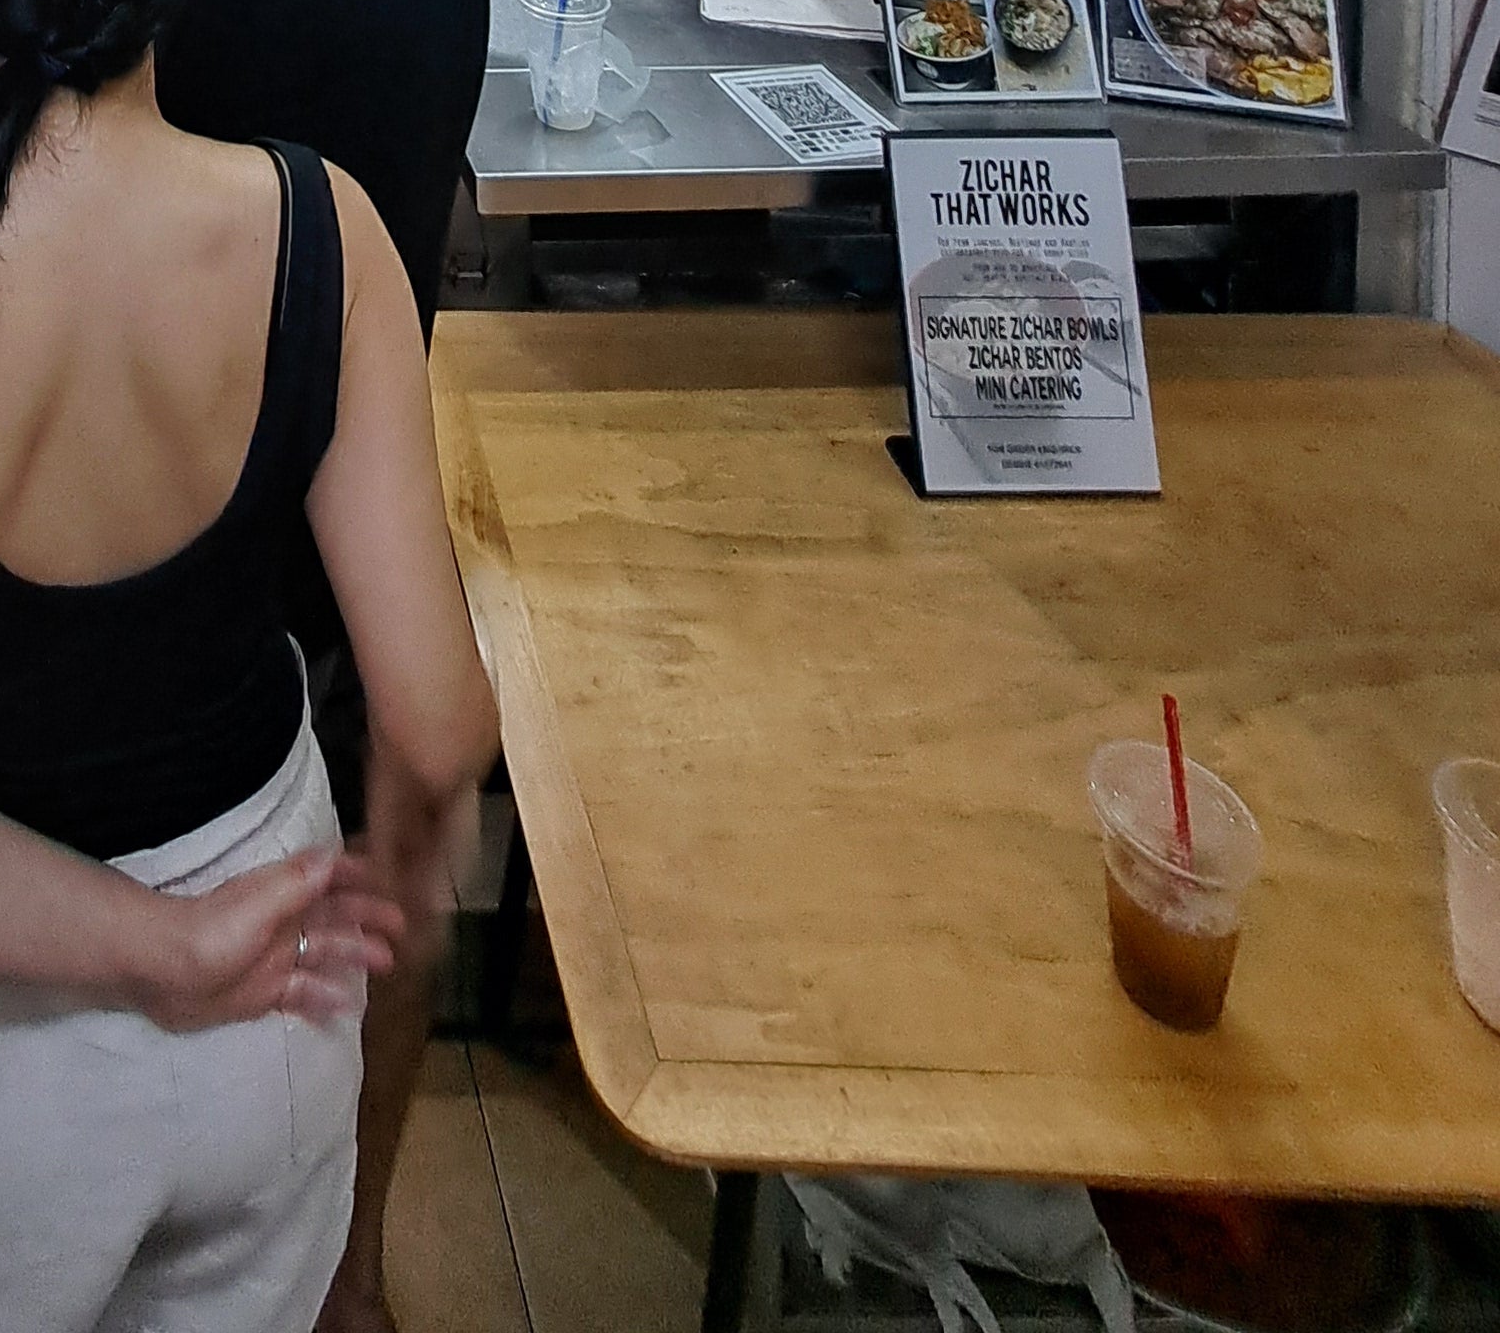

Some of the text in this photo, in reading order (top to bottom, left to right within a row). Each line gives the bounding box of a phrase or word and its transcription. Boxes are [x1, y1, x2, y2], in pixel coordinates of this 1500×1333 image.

[959, 159, 1053, 193] ZICHAR
[930, 193, 1091, 226] THAT WORKS
[927, 316, 1119, 342] SIGNATURE ZICHAR BOWLS
[968, 346, 1083, 370] ZICHAR BENTOS
[975, 376, 1083, 401] MINI CATERING
